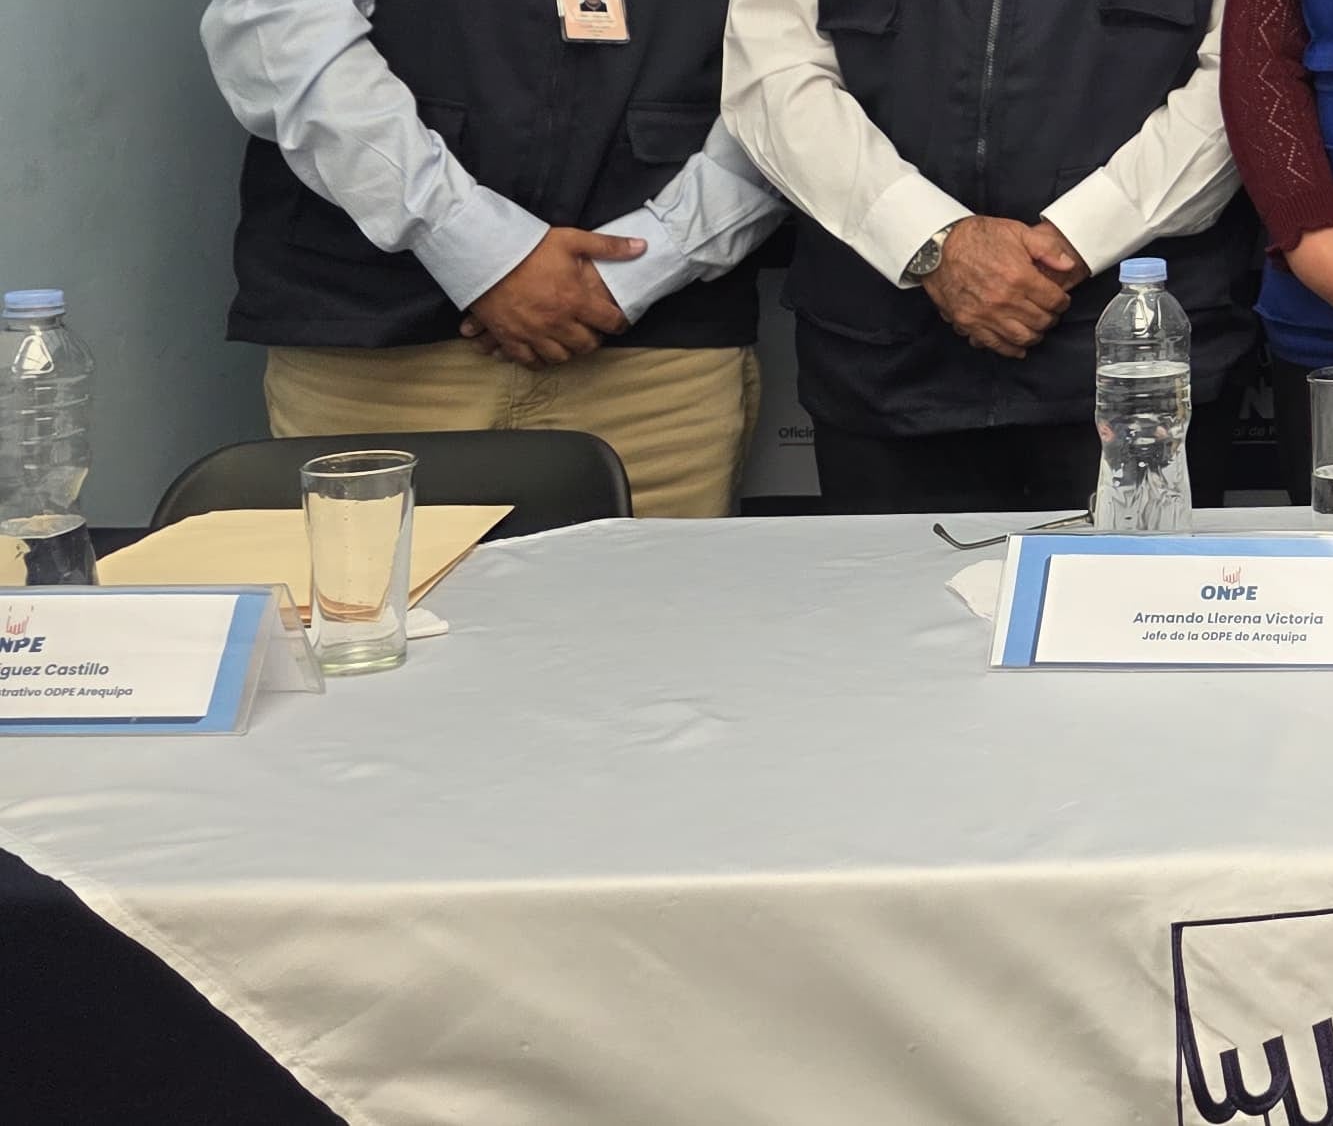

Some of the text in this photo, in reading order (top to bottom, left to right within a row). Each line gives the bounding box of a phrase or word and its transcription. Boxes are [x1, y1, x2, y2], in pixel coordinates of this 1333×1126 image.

[778, 426, 816, 439] Ofici
[1200, 585, 1258, 601] ONPE
[1133, 612, 1324, 625] Armando Llerena Victoria
[1142, 630, 1307, 644] Jefe de la ODPE de Arequipa
[0, 636, 46, 653] NPE
[0, 662, 109, 680] guez Castillo
[0, 686, 133, 699] trativo ODPE Arequipa
